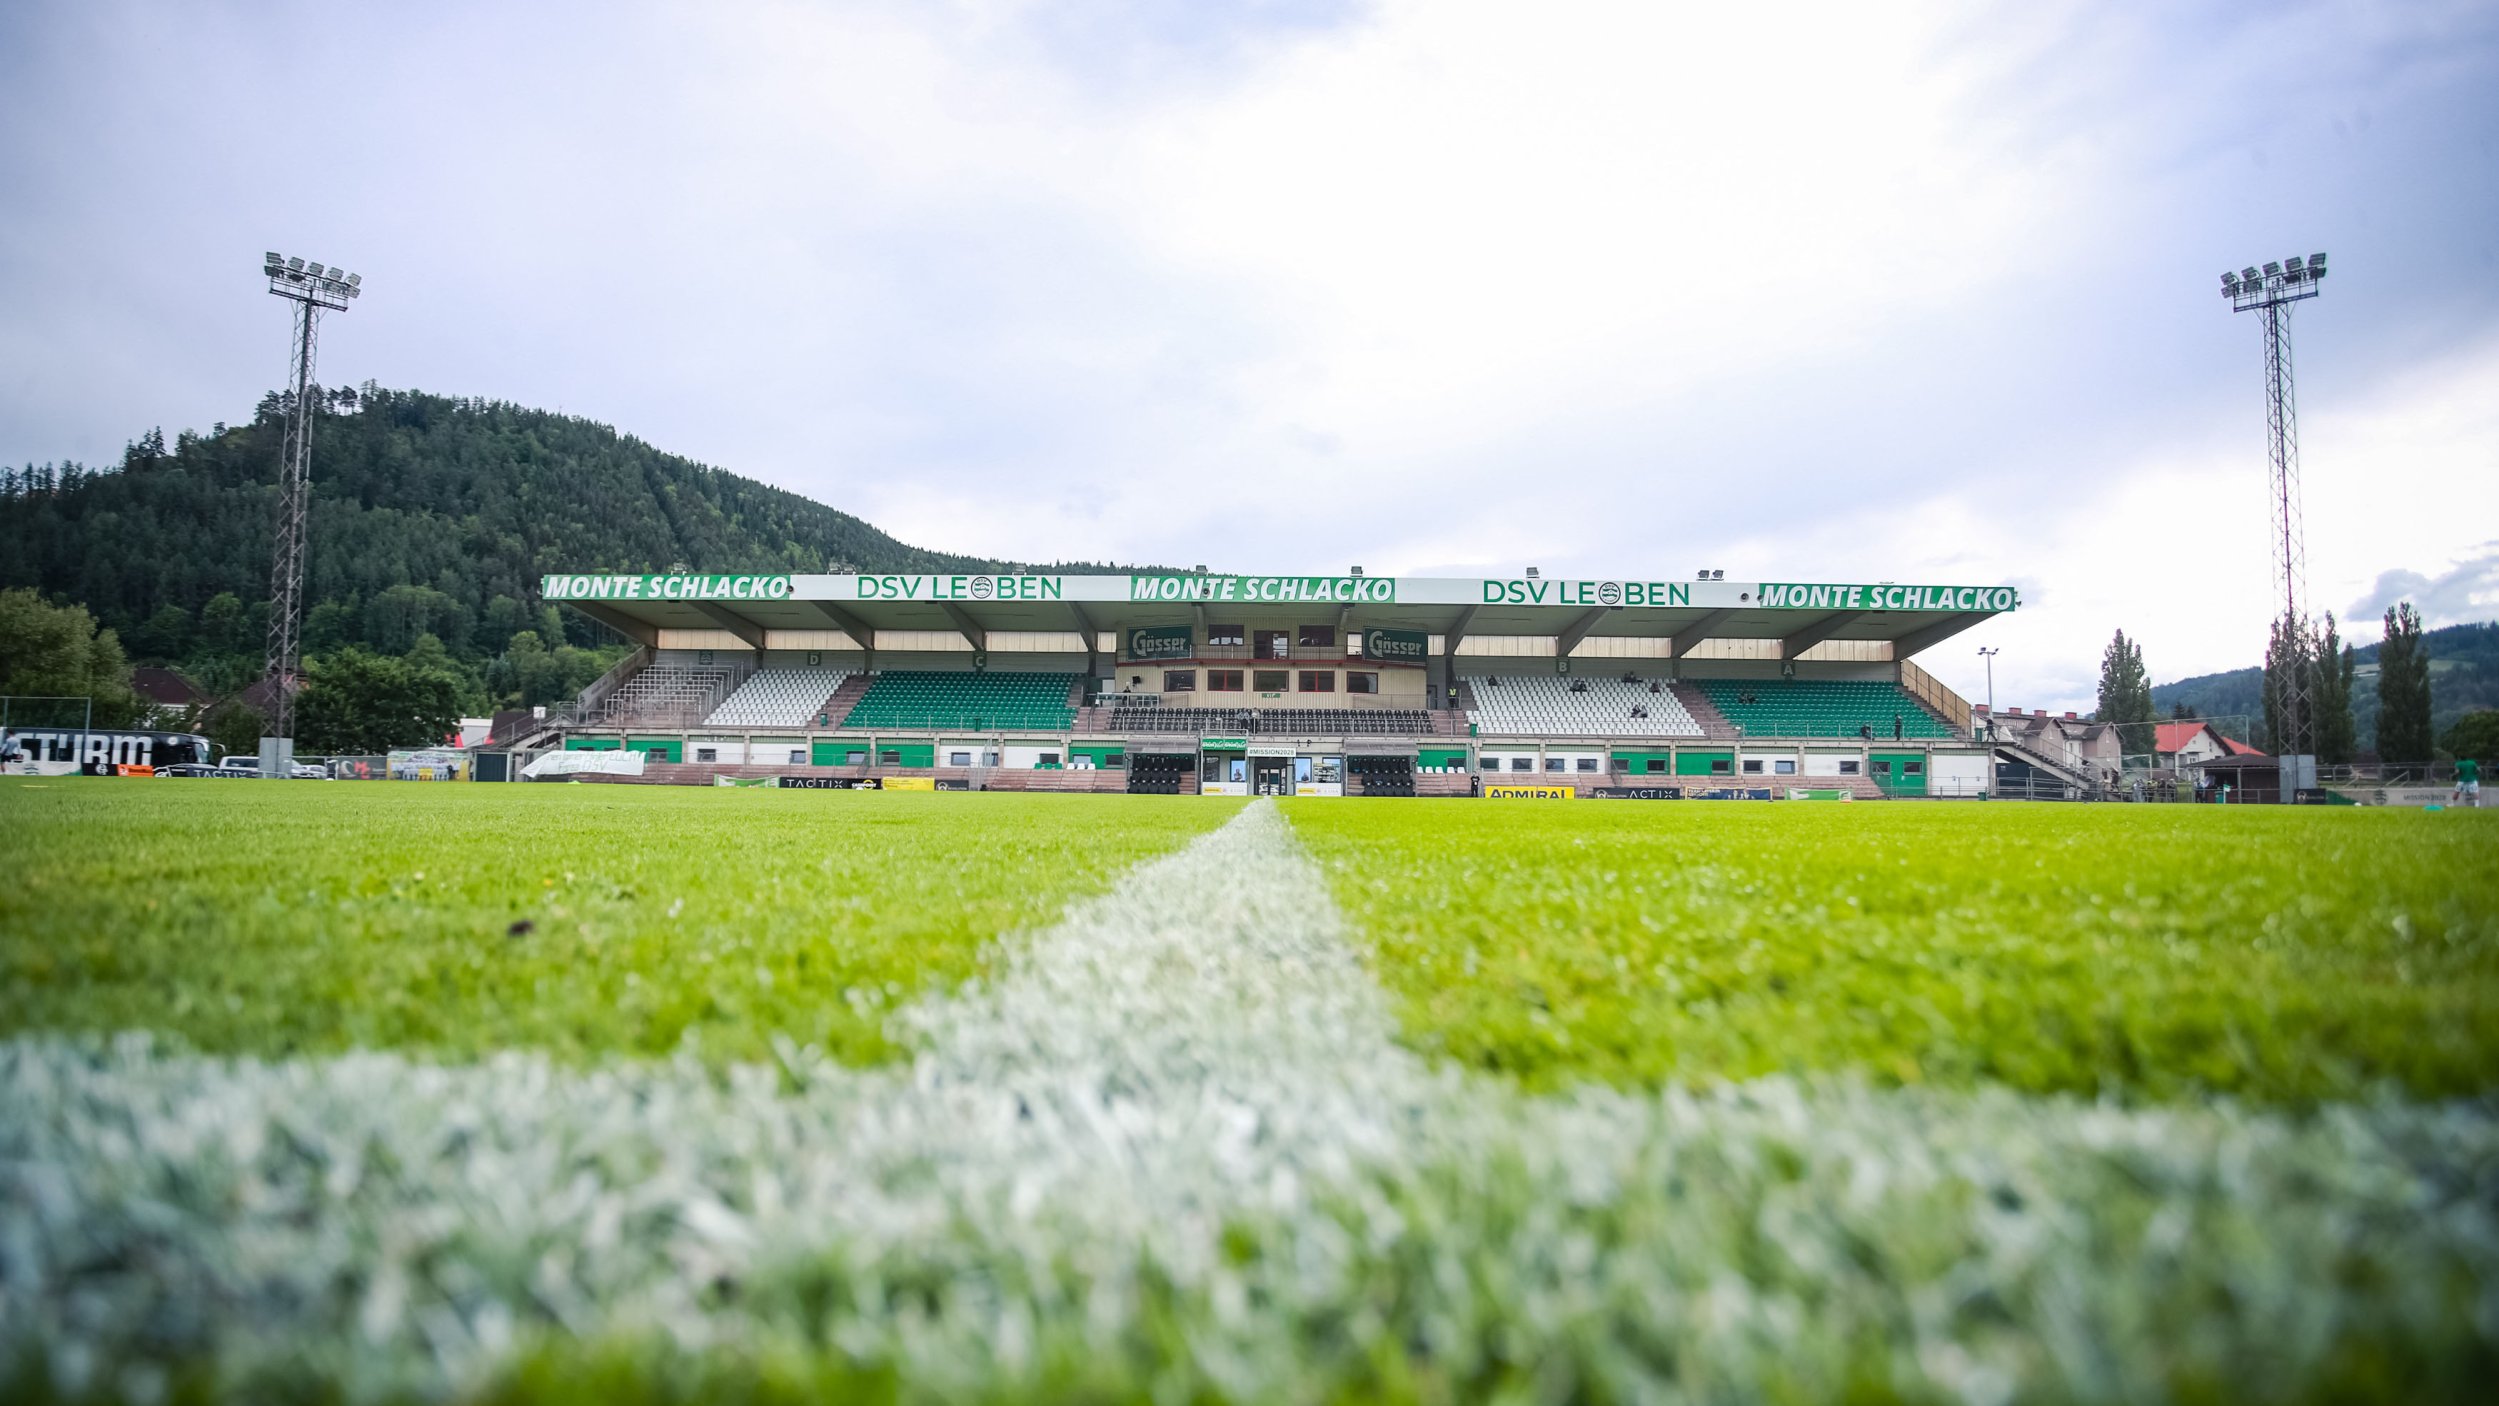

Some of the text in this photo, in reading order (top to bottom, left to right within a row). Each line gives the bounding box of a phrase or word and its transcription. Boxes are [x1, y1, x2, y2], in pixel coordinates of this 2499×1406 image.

[545, 576, 788, 599] MONTE SCHLACKO
[858, 576, 922, 599] DSV
[1133, 577, 1393, 601] MONTE SCHLACKO
[1483, 580, 1549, 604] DSV
[1762, 585, 2012, 610] MONTE SCHLACKO
[1132, 629, 1186, 657] Gösser
[1369, 630, 1422, 658] Gösser
[810, 655, 819, 665] D
[976, 656, 984, 666] C
[1559, 661, 1568, 672] B
[1784, 664, 1794, 674] A
[1249, 748, 1296, 756] #MISSION2028
[787, 779, 842, 788] TACTIX
[1490, 789, 1566, 799] ADMIRAL
